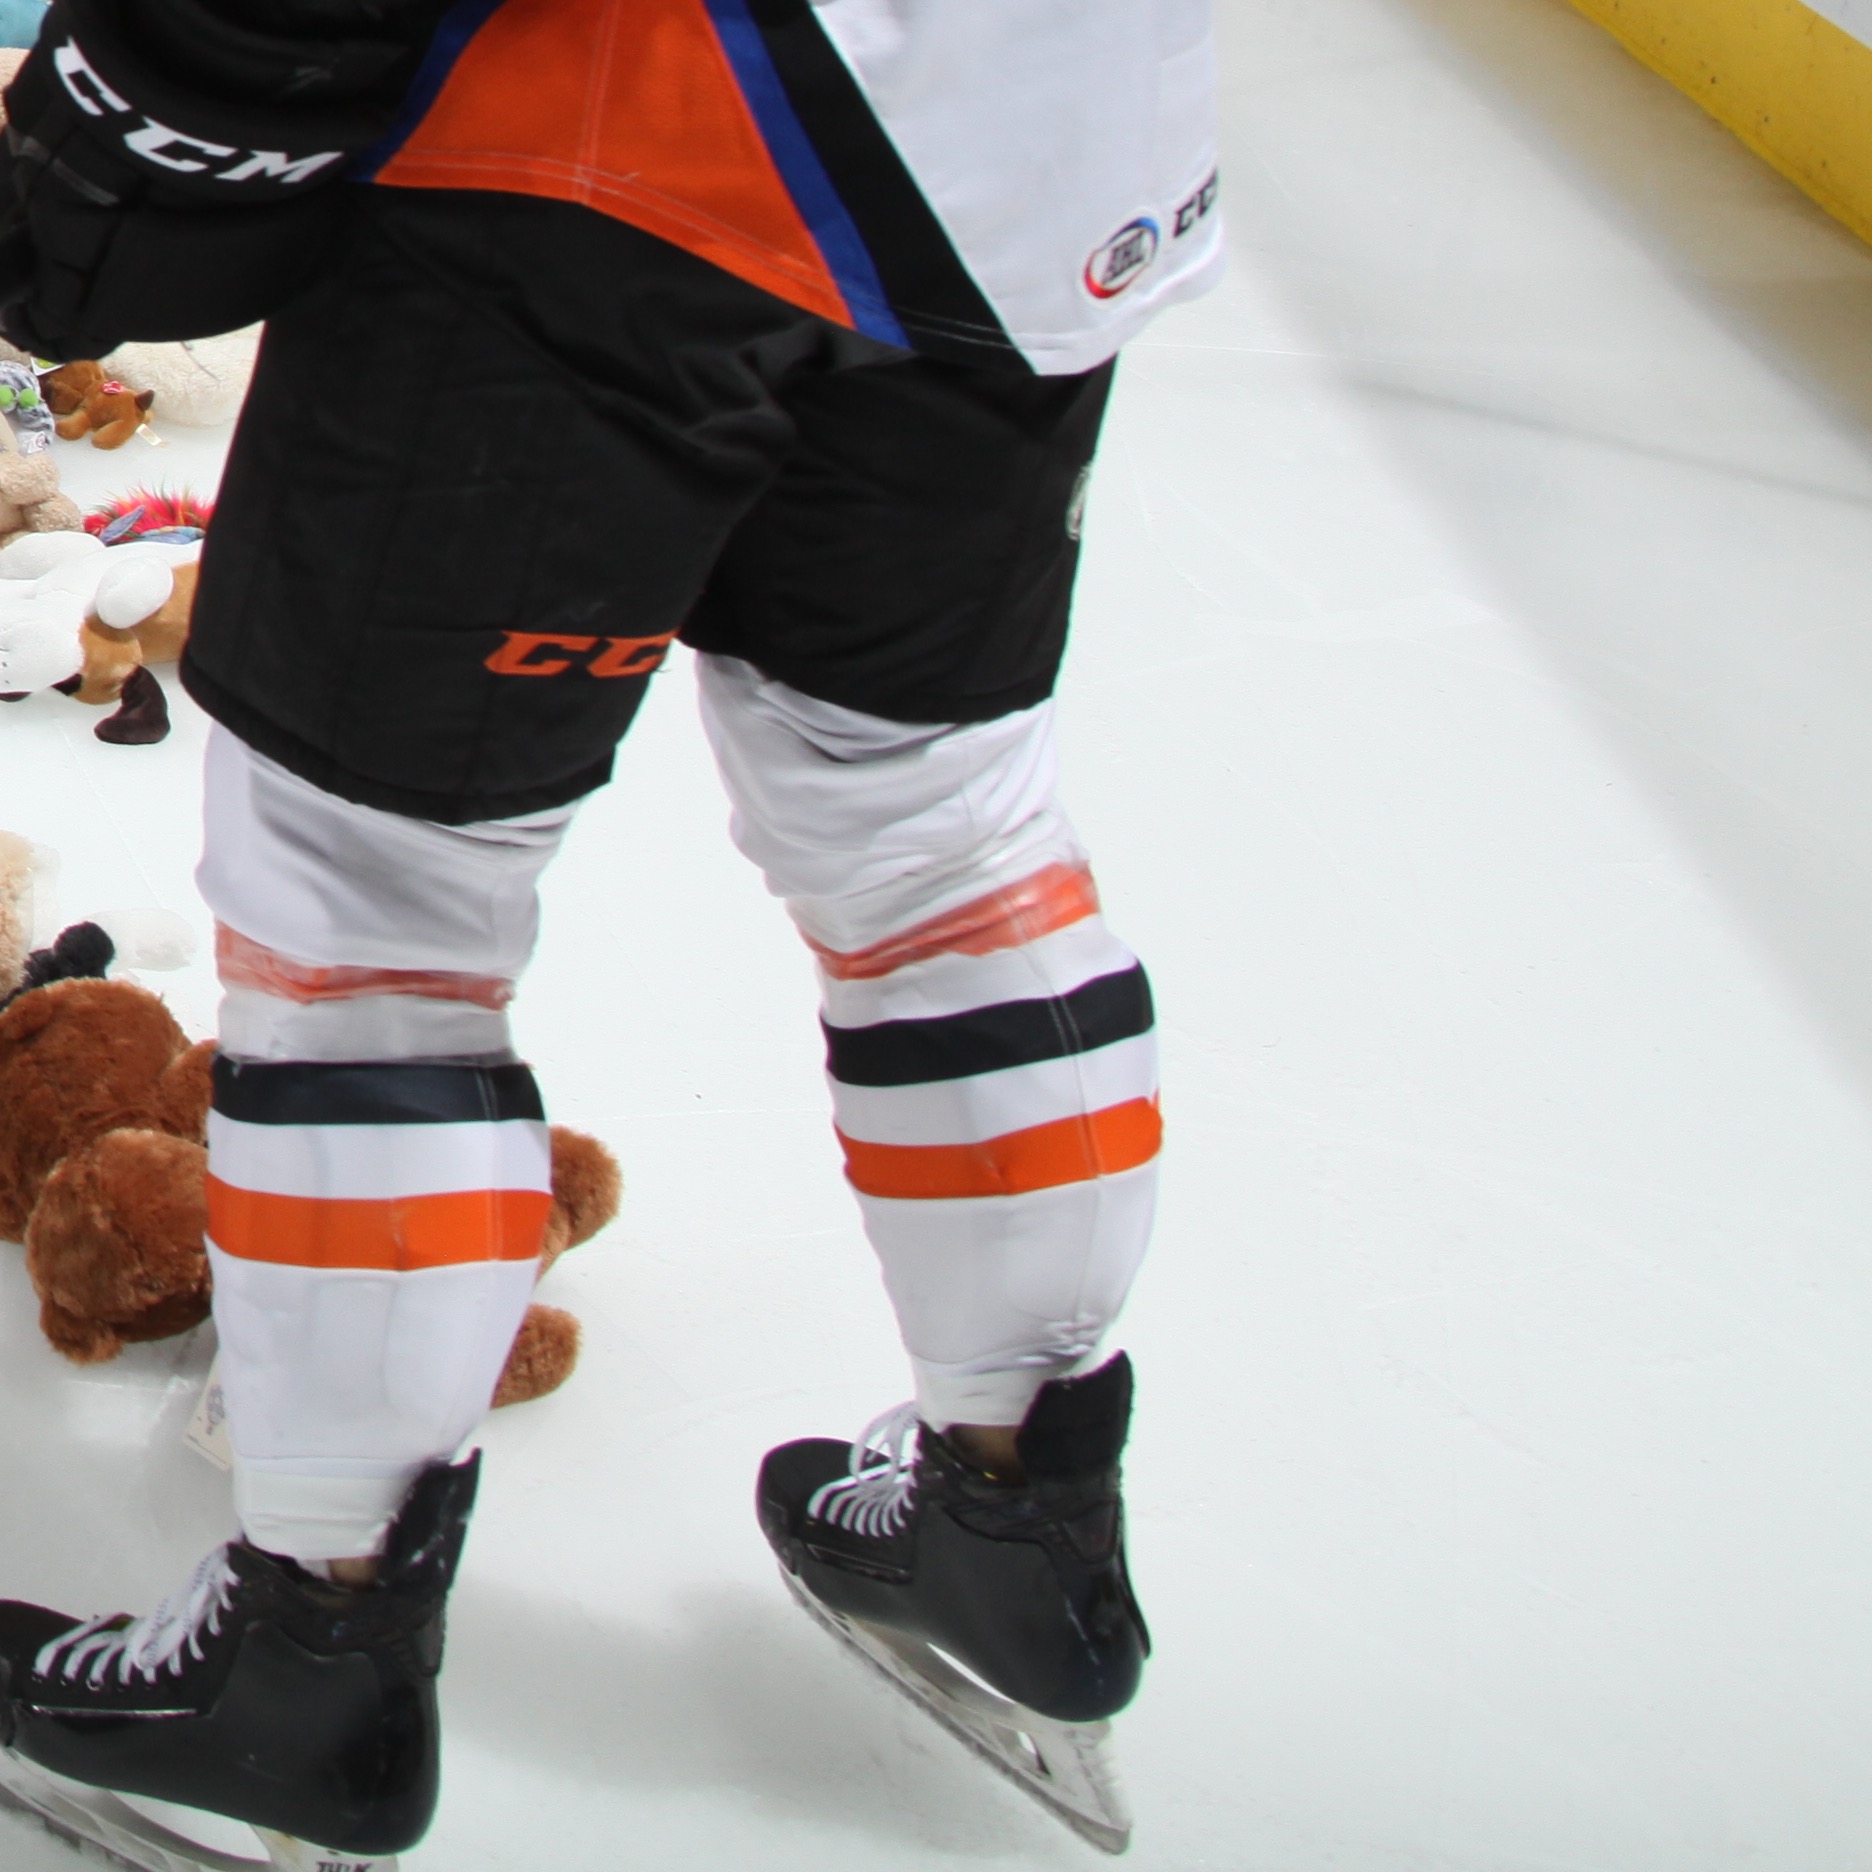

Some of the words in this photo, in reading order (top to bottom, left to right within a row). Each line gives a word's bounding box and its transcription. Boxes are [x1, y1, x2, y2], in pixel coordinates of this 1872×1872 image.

[55, 34, 344, 184] CCM
[1172, 168, 1218, 240] CC
[484, 630, 676, 679] CC
